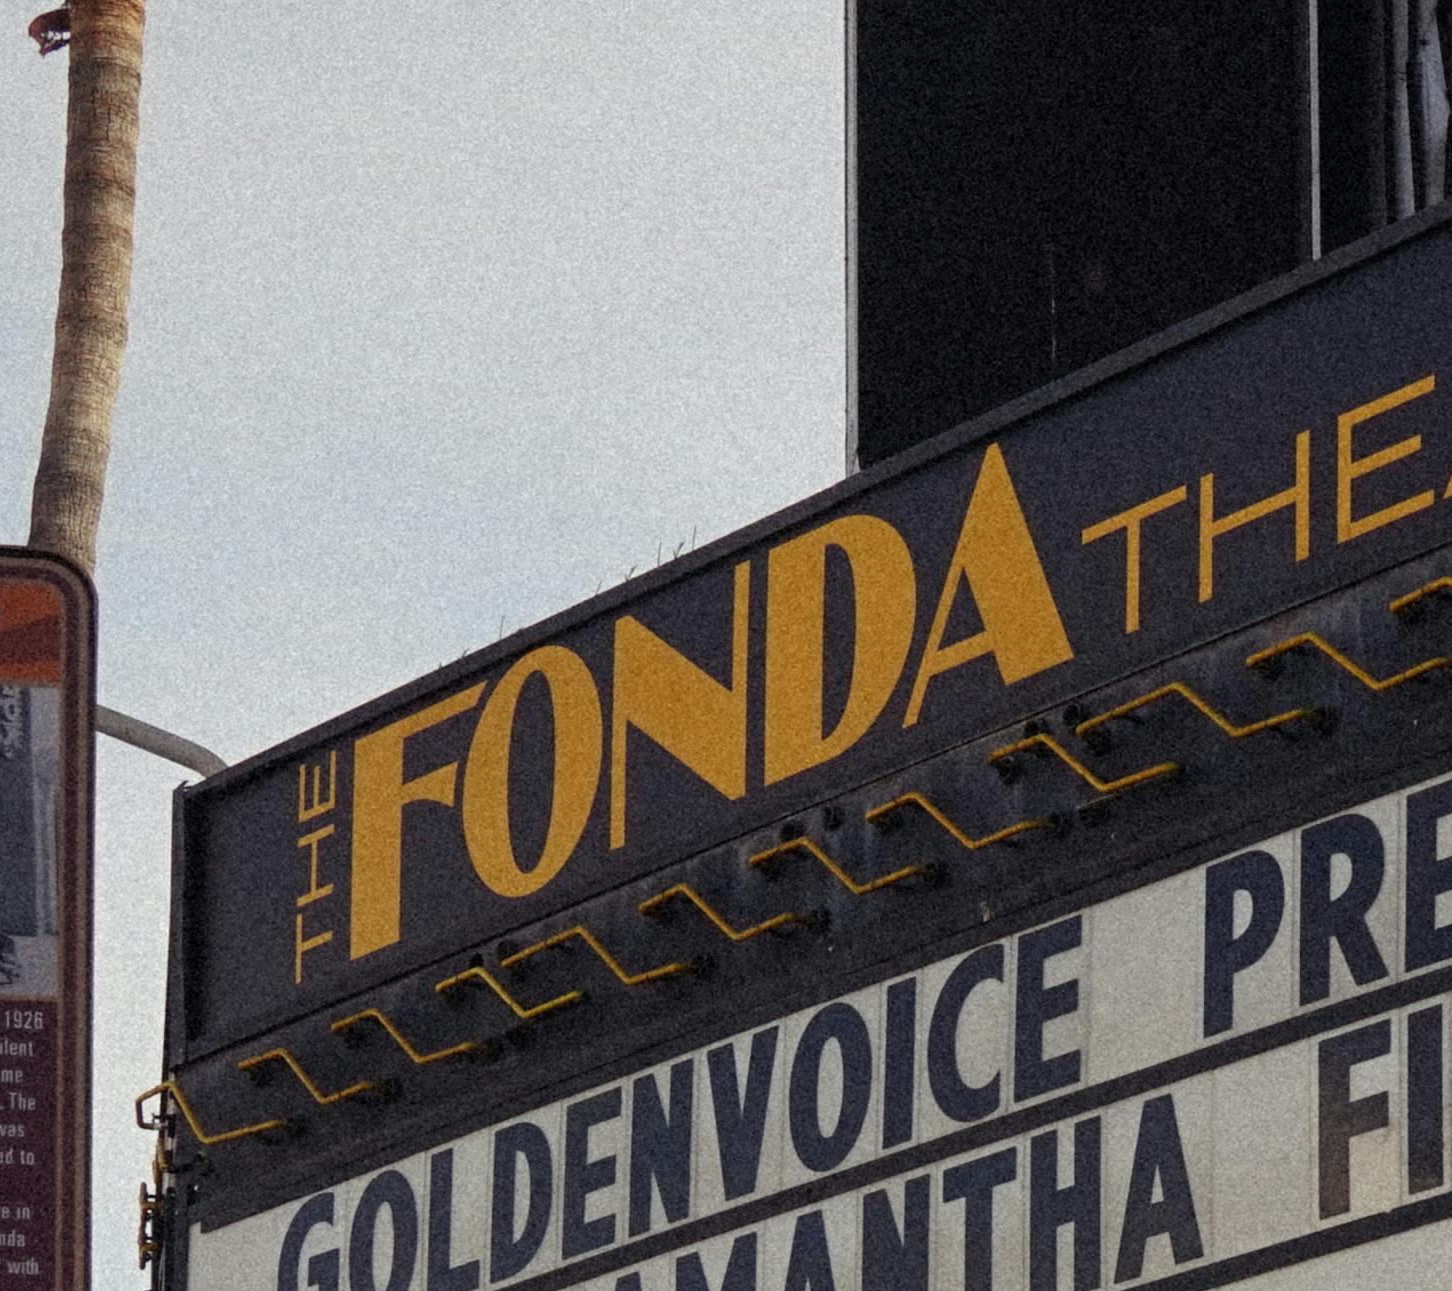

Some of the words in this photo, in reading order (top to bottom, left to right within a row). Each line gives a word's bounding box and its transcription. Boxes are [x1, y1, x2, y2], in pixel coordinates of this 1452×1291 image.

[289, 743, 340, 988] THE
[345, 441, 1078, 963] FONDA
[4, 1010, 43, 1030] 1926
